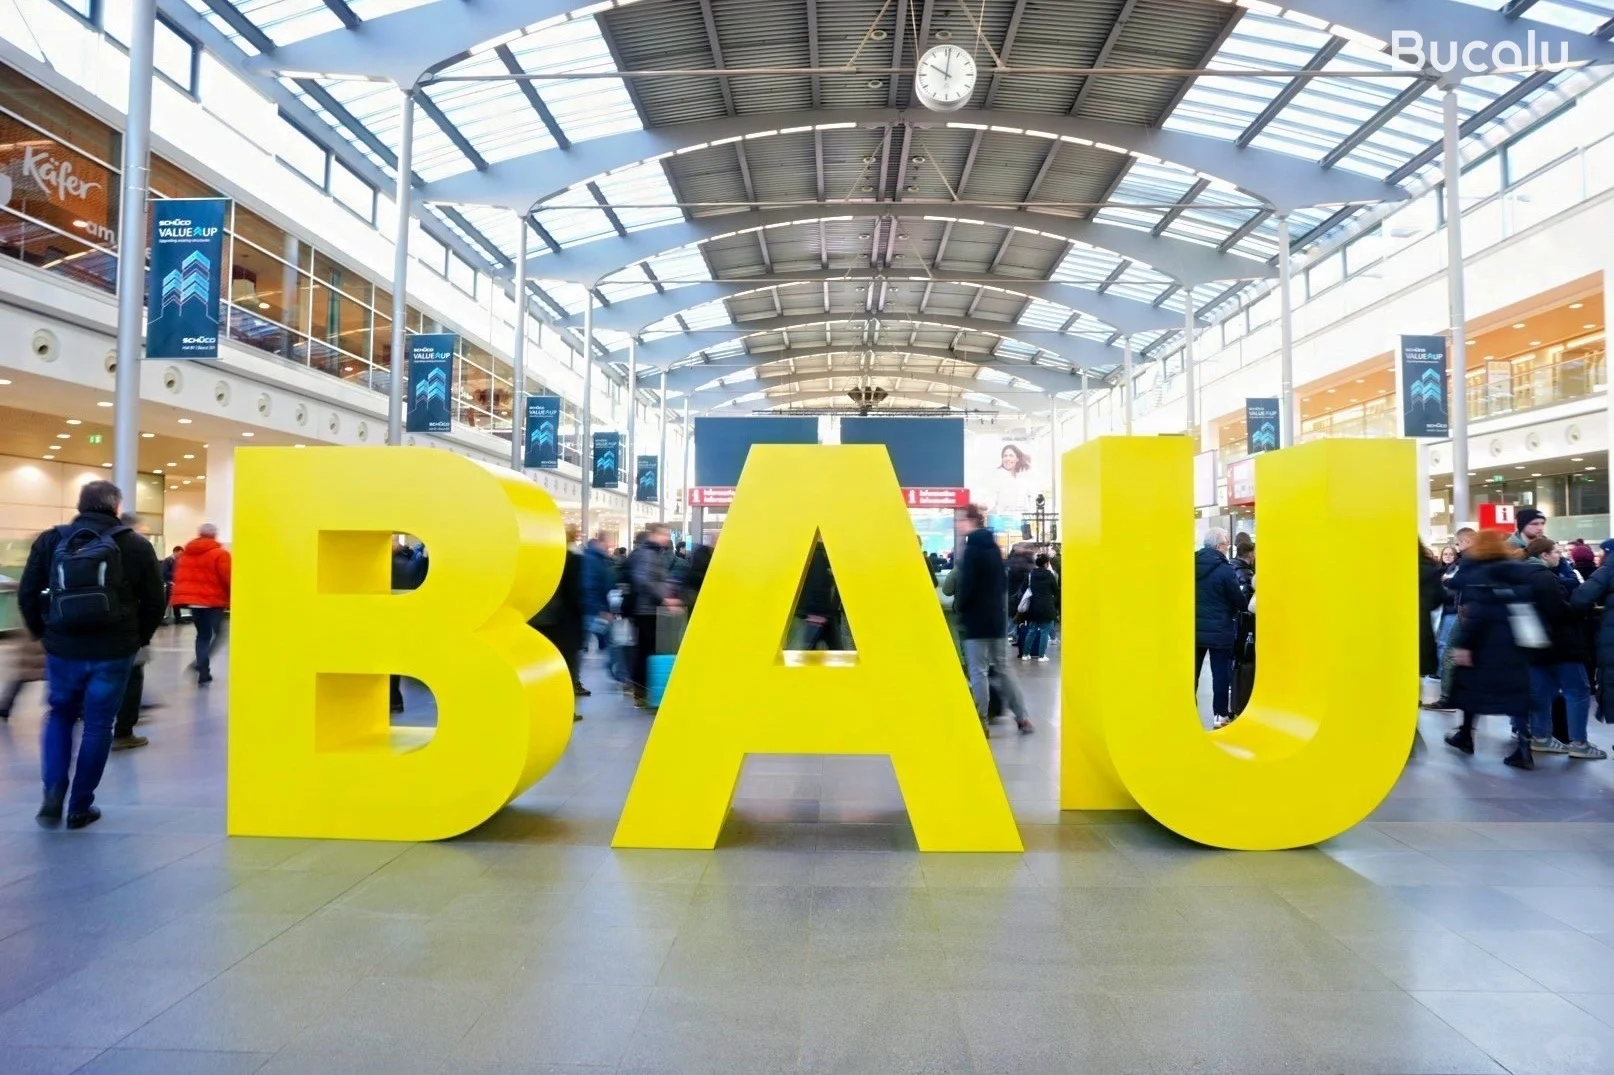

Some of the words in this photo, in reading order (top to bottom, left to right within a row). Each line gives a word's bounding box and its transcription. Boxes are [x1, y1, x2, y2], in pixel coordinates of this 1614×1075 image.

[22, 145, 102, 201] Käfer
[158, 218, 192, 226] SCHÜCO
[158, 227, 193, 238] VALUE
[202, 227, 218, 237] UP
[182, 335, 216, 344] SCHÜCO
[413, 352, 435, 360] VALUE
[227, 434, 1418, 852] BAU
